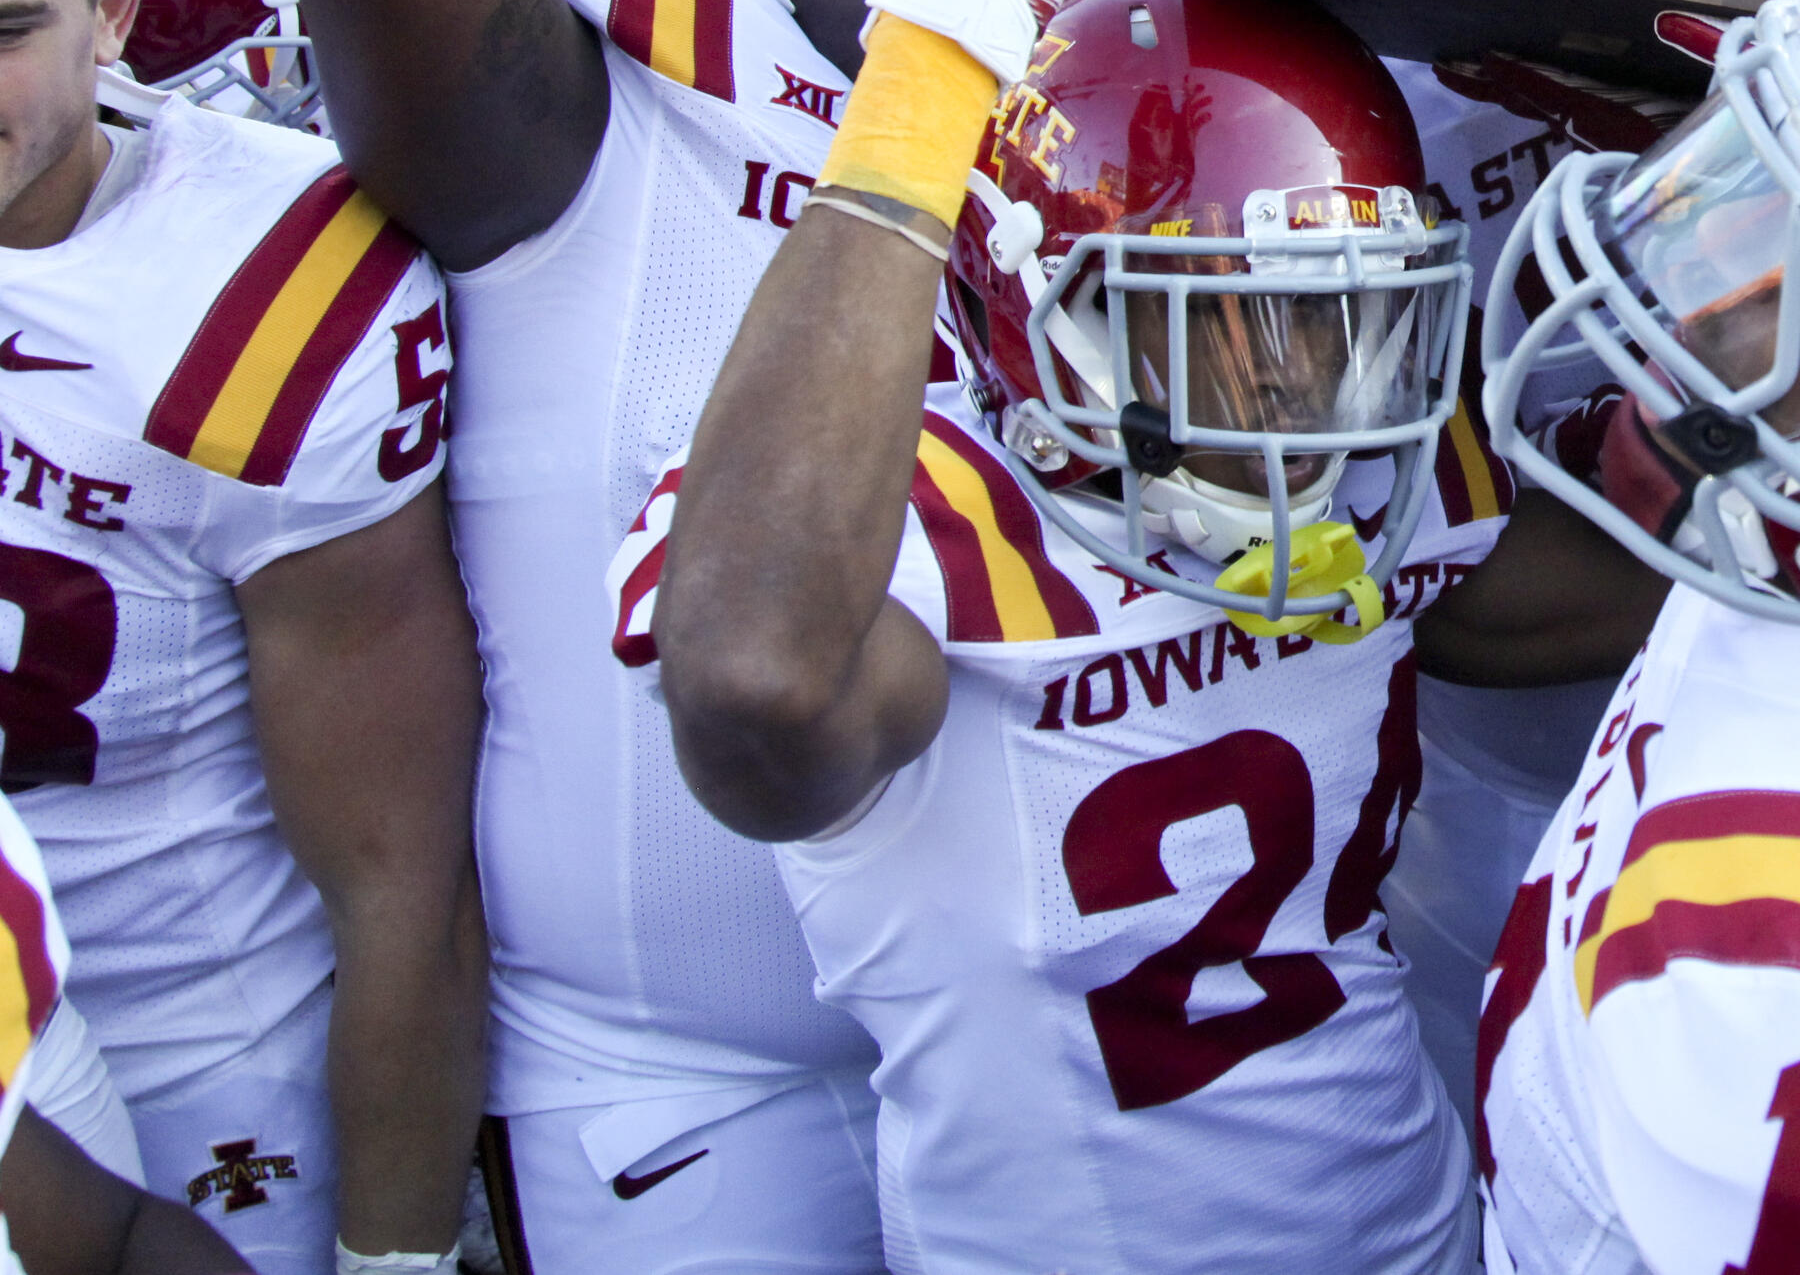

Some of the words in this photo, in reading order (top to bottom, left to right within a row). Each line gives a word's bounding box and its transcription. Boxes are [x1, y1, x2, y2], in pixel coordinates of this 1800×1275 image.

[1149, 218, 1194, 238] NIKE
[1352, 199, 1378, 224] IN
[378, 299, 454, 483] 5
[1033, 620, 1261, 731] IOWA
[1061, 646, 1423, 1113] 24
